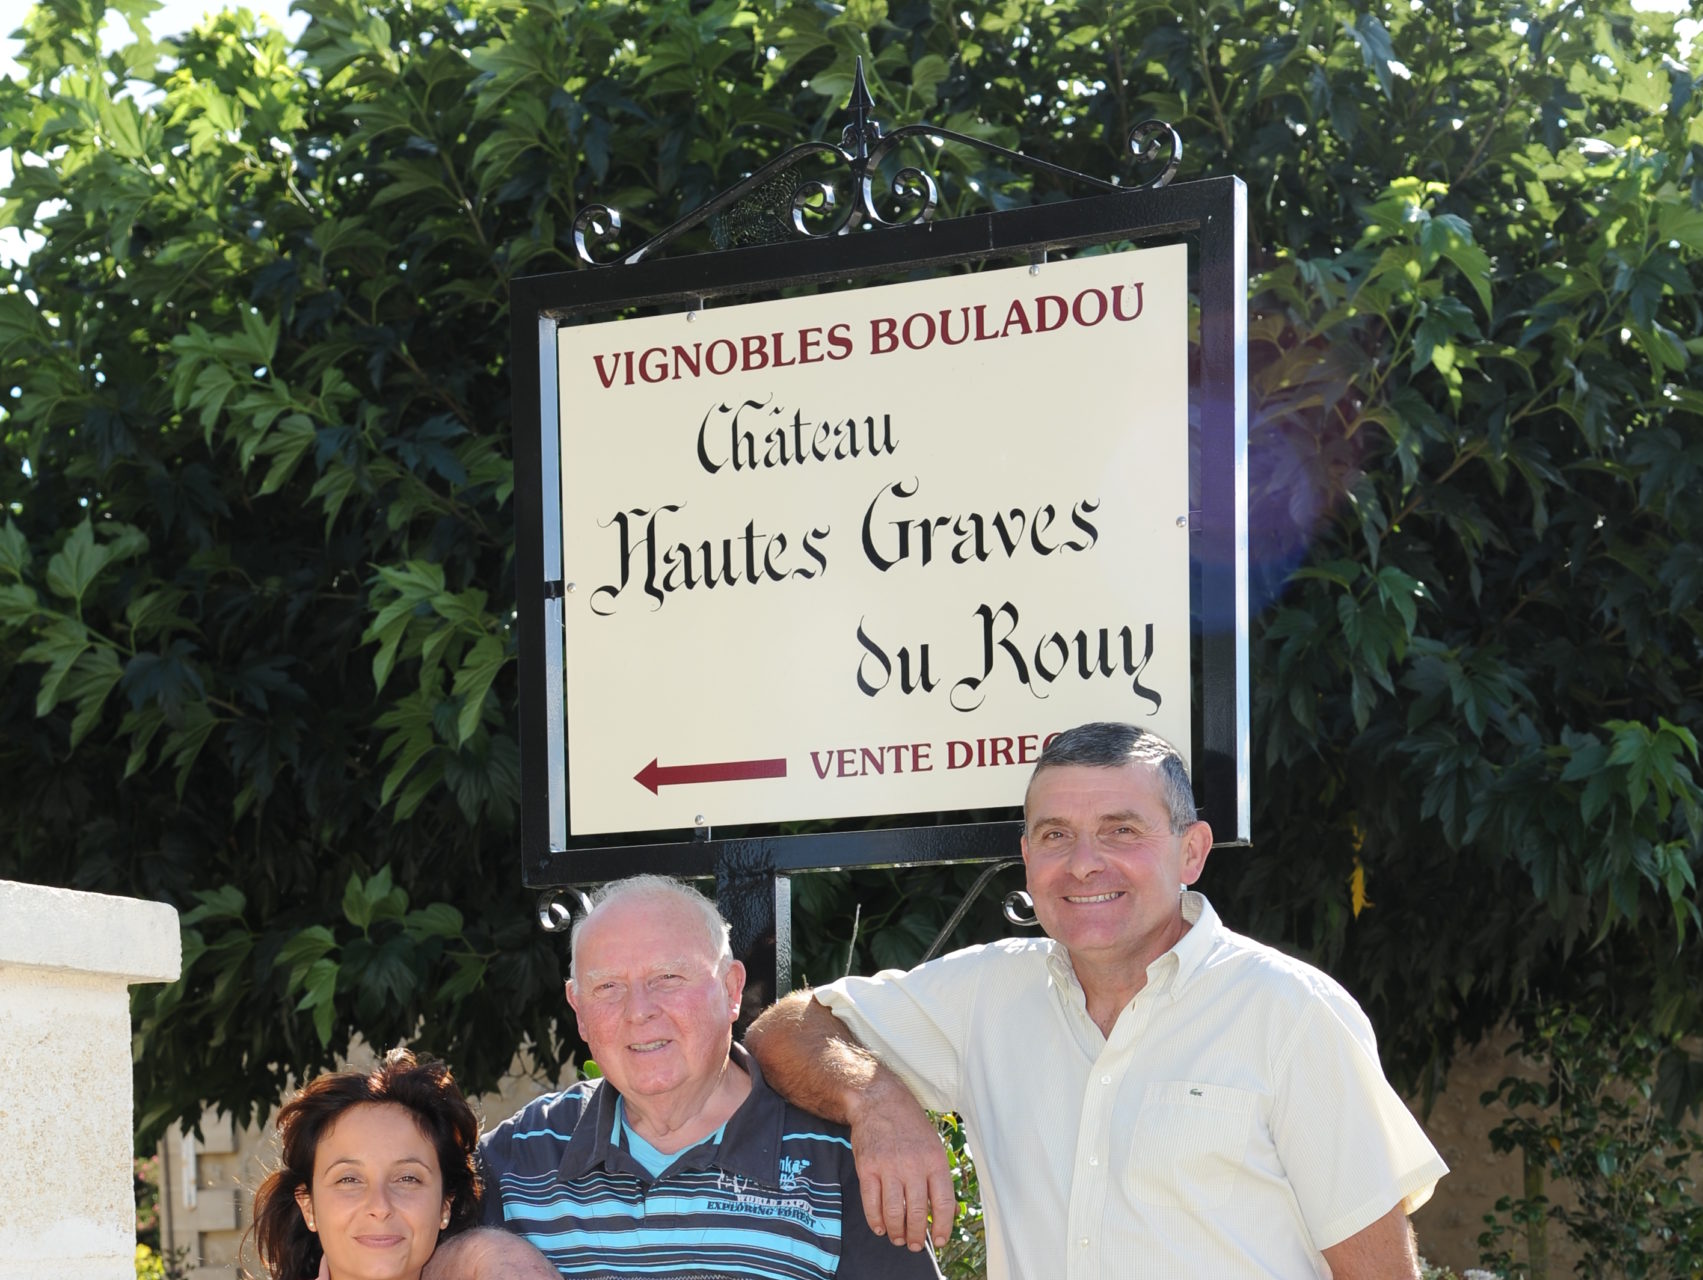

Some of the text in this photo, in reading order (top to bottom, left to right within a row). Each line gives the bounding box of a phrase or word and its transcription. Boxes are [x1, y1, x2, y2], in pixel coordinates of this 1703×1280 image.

[593, 282, 1145, 389] VIGNOBLES BOULADOU
[697, 392, 899, 474] Château
[590, 476, 1100, 616] Hautes Graves
[856, 601, 1162, 716] du Rouy
[809, 743, 934, 780] VENTE
[706, 1200, 817, 1228] EXPLORING FOREST
